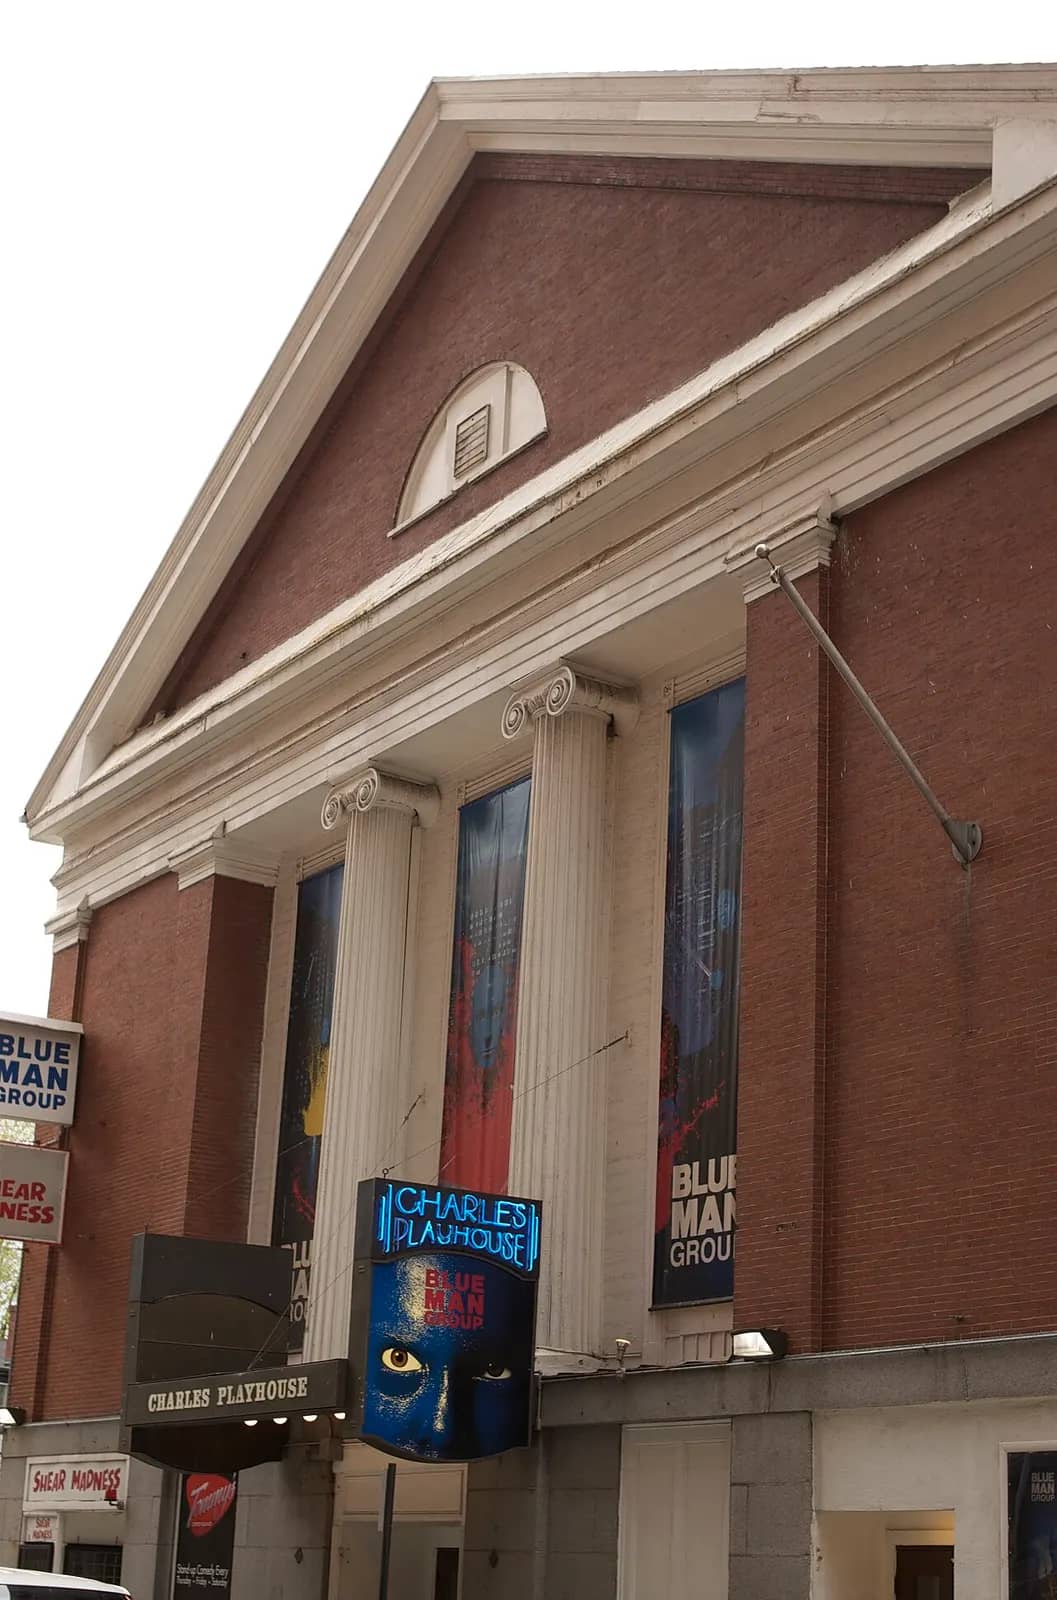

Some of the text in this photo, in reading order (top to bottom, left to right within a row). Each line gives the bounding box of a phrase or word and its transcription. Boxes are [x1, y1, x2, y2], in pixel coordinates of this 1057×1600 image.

[0, 1033, 71, 1065] BLUE
[0, 1059, 69, 1091] MAN
[0, 1179, 46, 1202] EAR
[394, 1187, 527, 1229] CHARLES
[393, 1217, 525, 1267] PLAYHOUSE
[670, 1233, 735, 1268] GROU
[425, 1269, 486, 1294] BLUE
[424, 1288, 485, 1316] MAN
[424, 1312, 484, 1330] GROUP
[148, 1376, 308, 1413] CHARLES PLAYHOUSE
[33, 1468, 121, 1493] SHEAR MADNESS
[1031, 1471, 1055, 1483] BLUE
[1031, 1482, 1055, 1495] MAN
